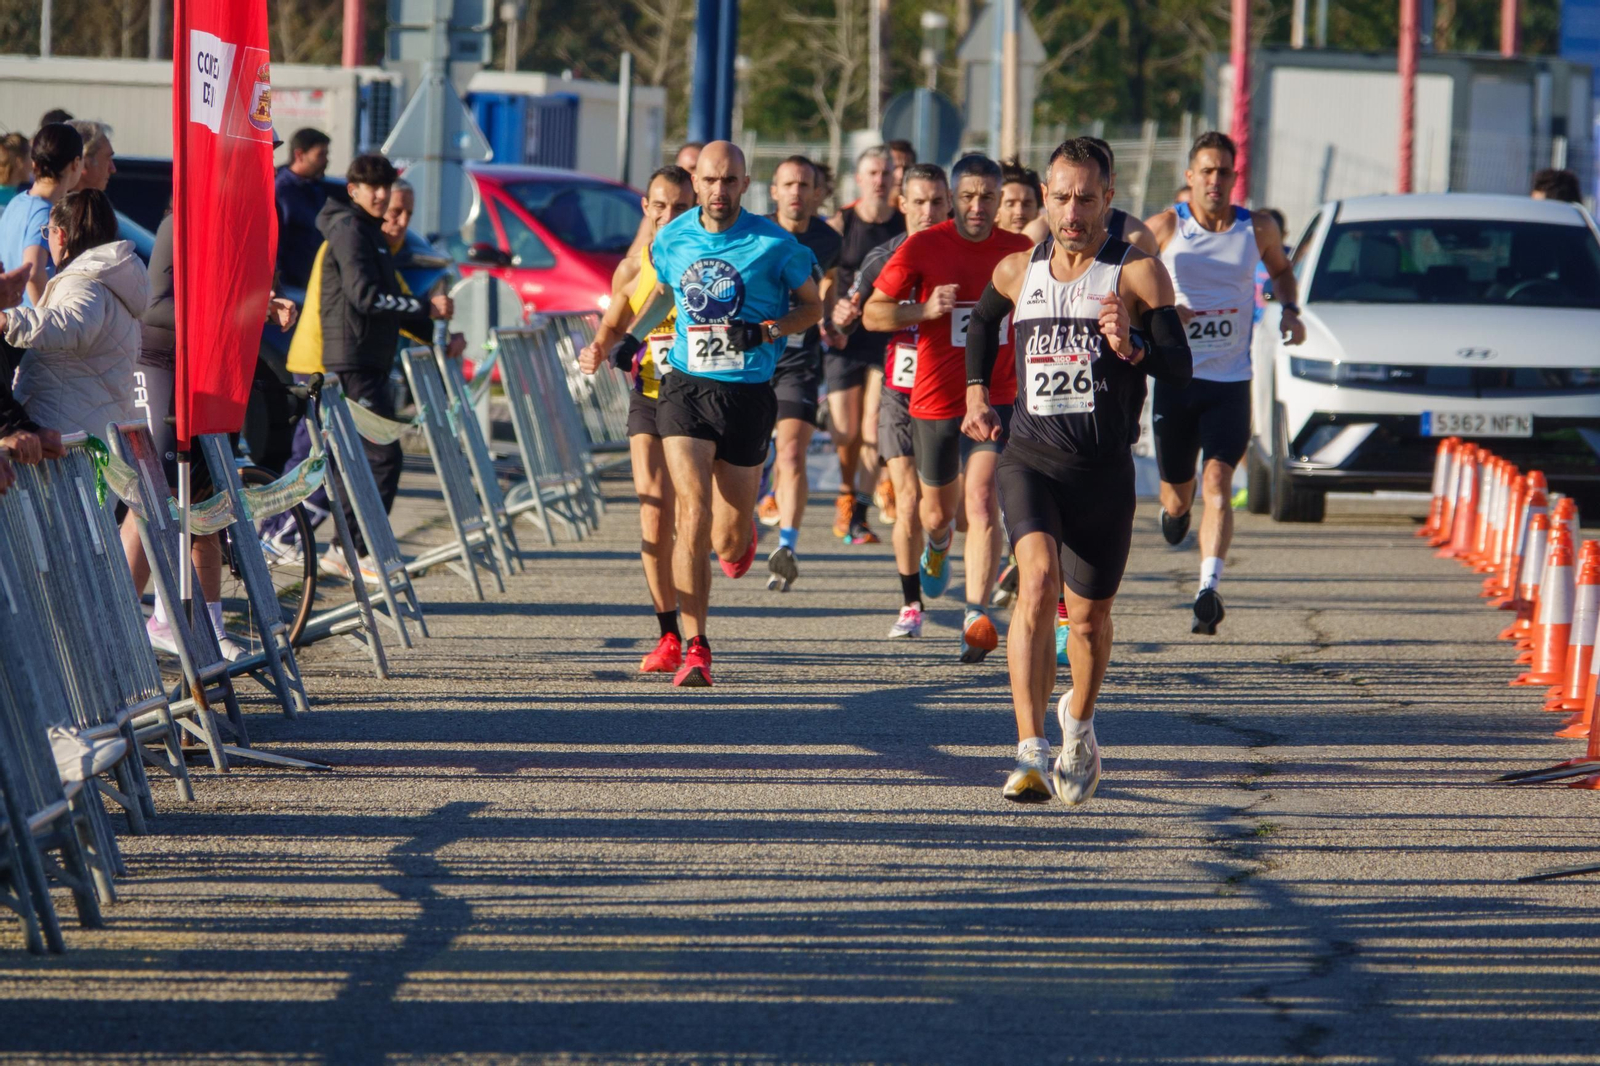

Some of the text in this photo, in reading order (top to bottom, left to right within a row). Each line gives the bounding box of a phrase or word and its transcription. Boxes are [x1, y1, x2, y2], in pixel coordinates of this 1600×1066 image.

[1189, 320, 1232, 339] 240
[1034, 369, 1091, 397] 226
[1437, 414, 1486, 433] 5362
